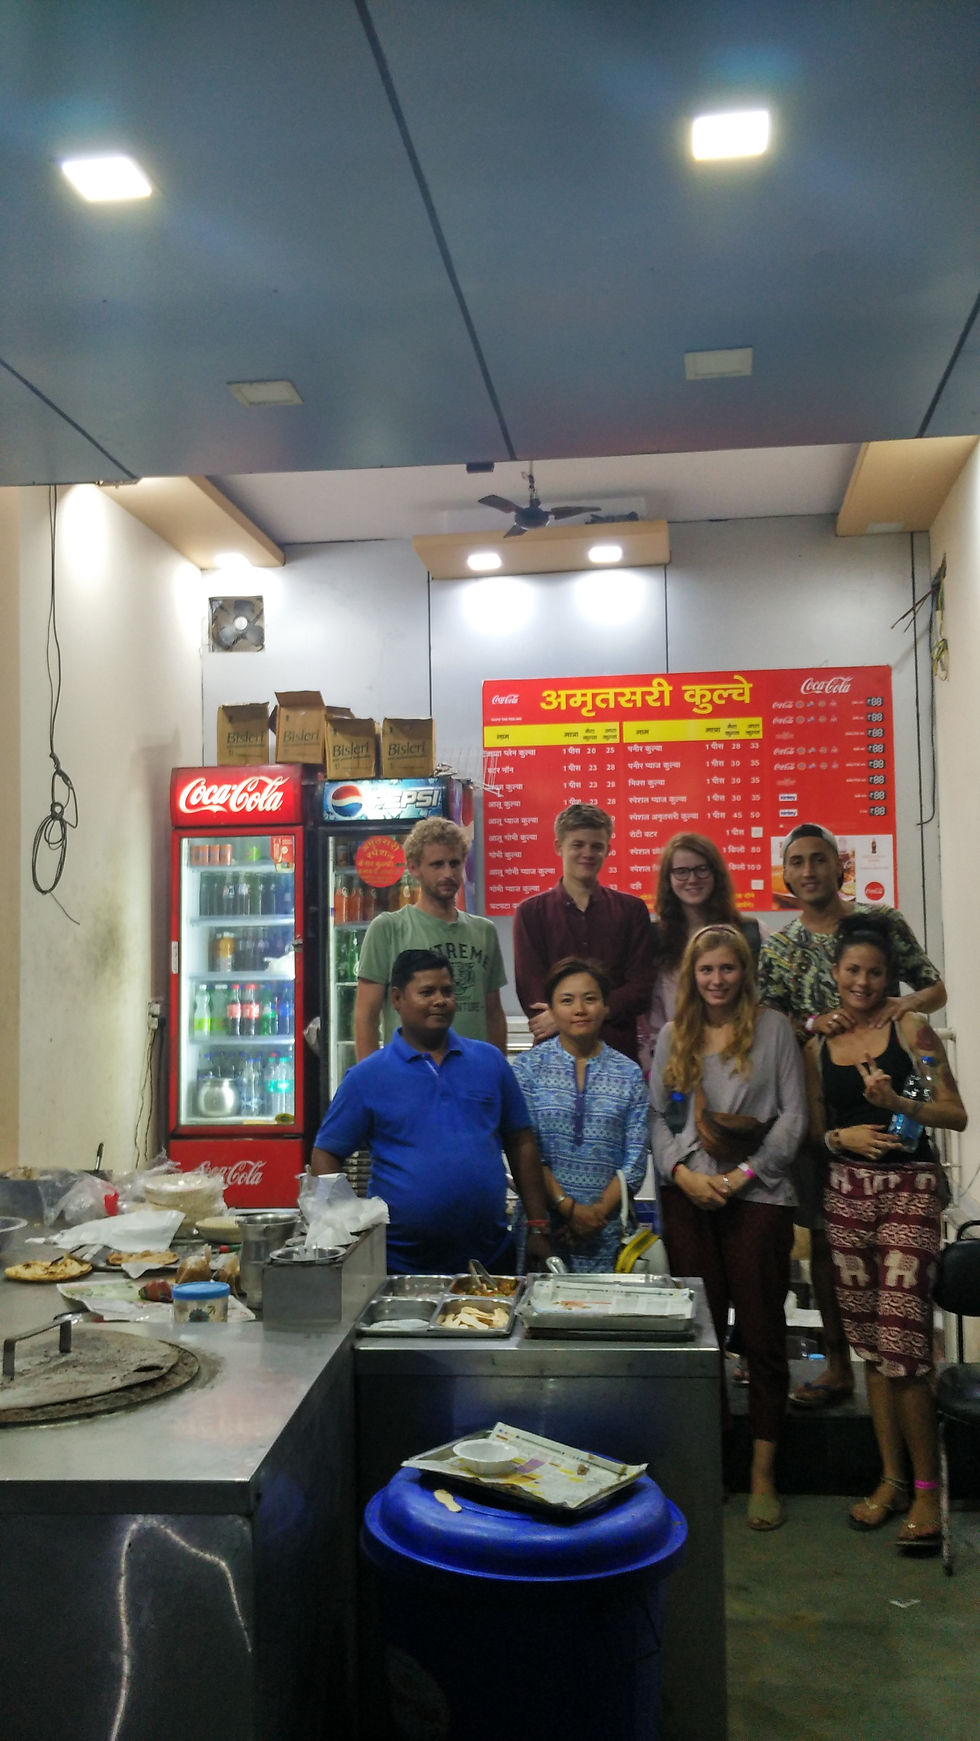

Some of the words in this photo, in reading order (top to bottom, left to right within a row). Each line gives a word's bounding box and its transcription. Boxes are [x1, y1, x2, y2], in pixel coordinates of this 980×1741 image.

[801, 676, 853, 694] Coca-Cola
[492, 694, 519, 704] Coca-Cola
[540, 678, 672, 717] अमृतसरी
[682, 675, 753, 714] कुल्चे
[227, 732, 264, 744] Bisleri
[283, 730, 320, 743] Bisleri
[332, 742, 369, 757] Bisleri
[388, 742, 425, 757] Bisleri
[180, 776, 290, 813] Coca-Cola
